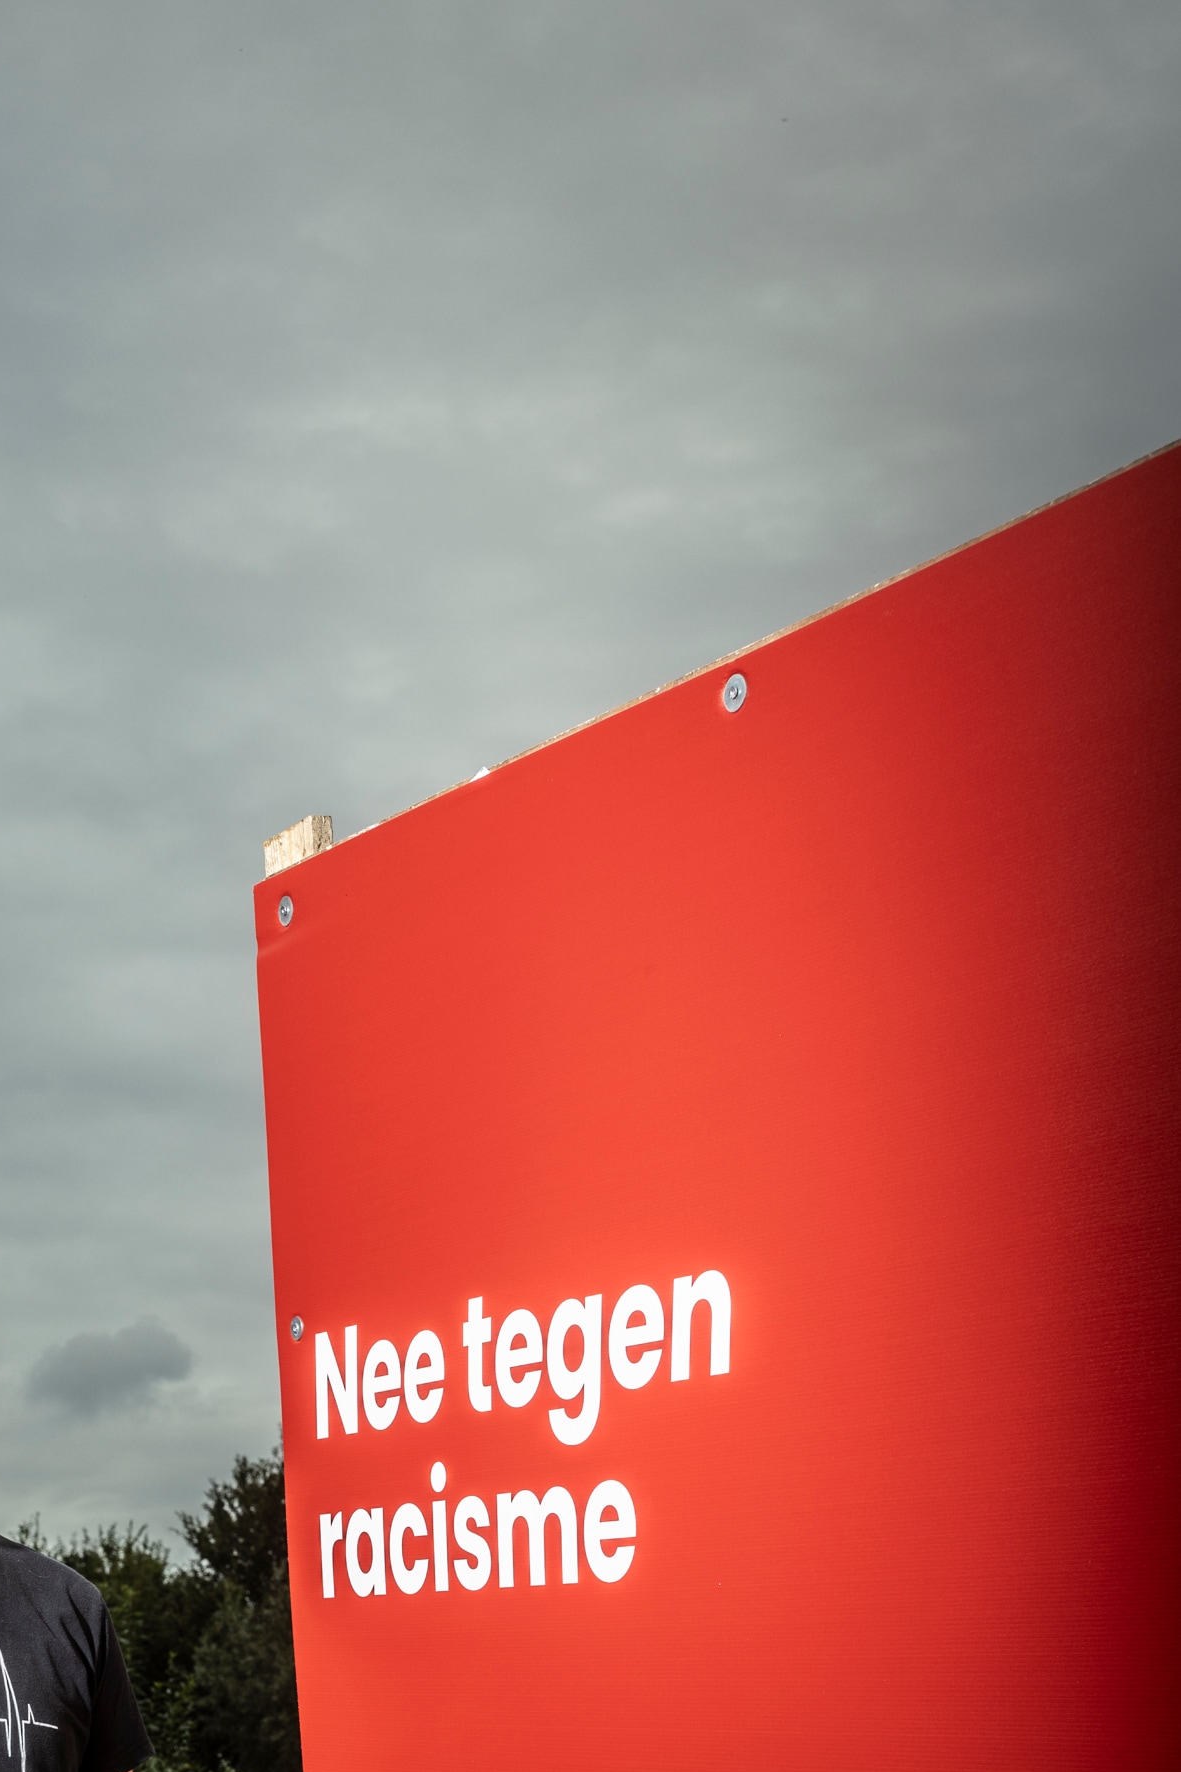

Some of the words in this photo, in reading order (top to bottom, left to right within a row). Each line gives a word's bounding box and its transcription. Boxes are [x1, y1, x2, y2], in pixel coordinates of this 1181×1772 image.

[314, 1324, 445, 1440] Nee
[462, 1269, 732, 1446] tegen
[319, 1461, 637, 1599] racisme
